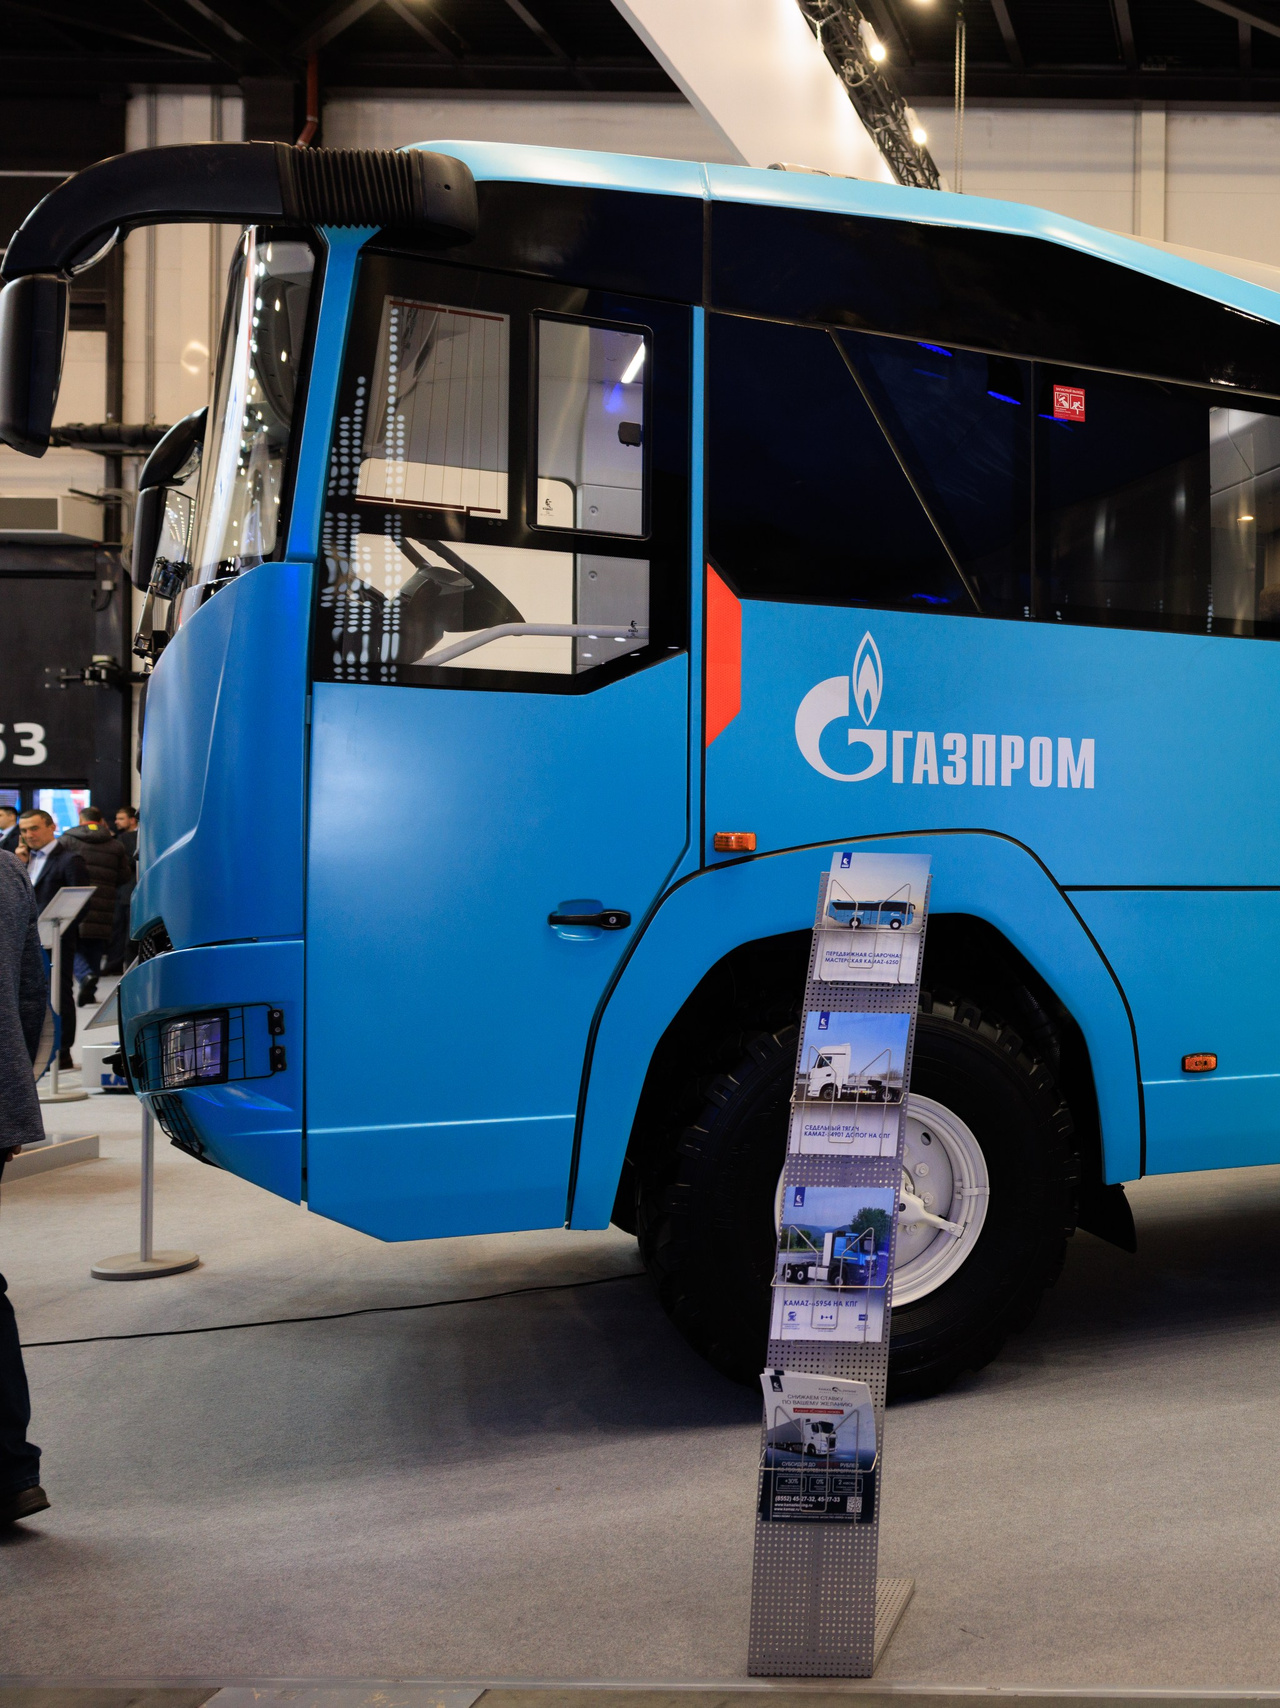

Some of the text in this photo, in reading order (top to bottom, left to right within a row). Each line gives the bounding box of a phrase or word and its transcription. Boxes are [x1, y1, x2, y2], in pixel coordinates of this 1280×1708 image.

[0, 722, 48, 766] 3
[892, 730, 1095, 789] ГАЗПРОМ
[833, 1300, 843, 1308] НА
[845, 1300, 859, 1308] КПГ
